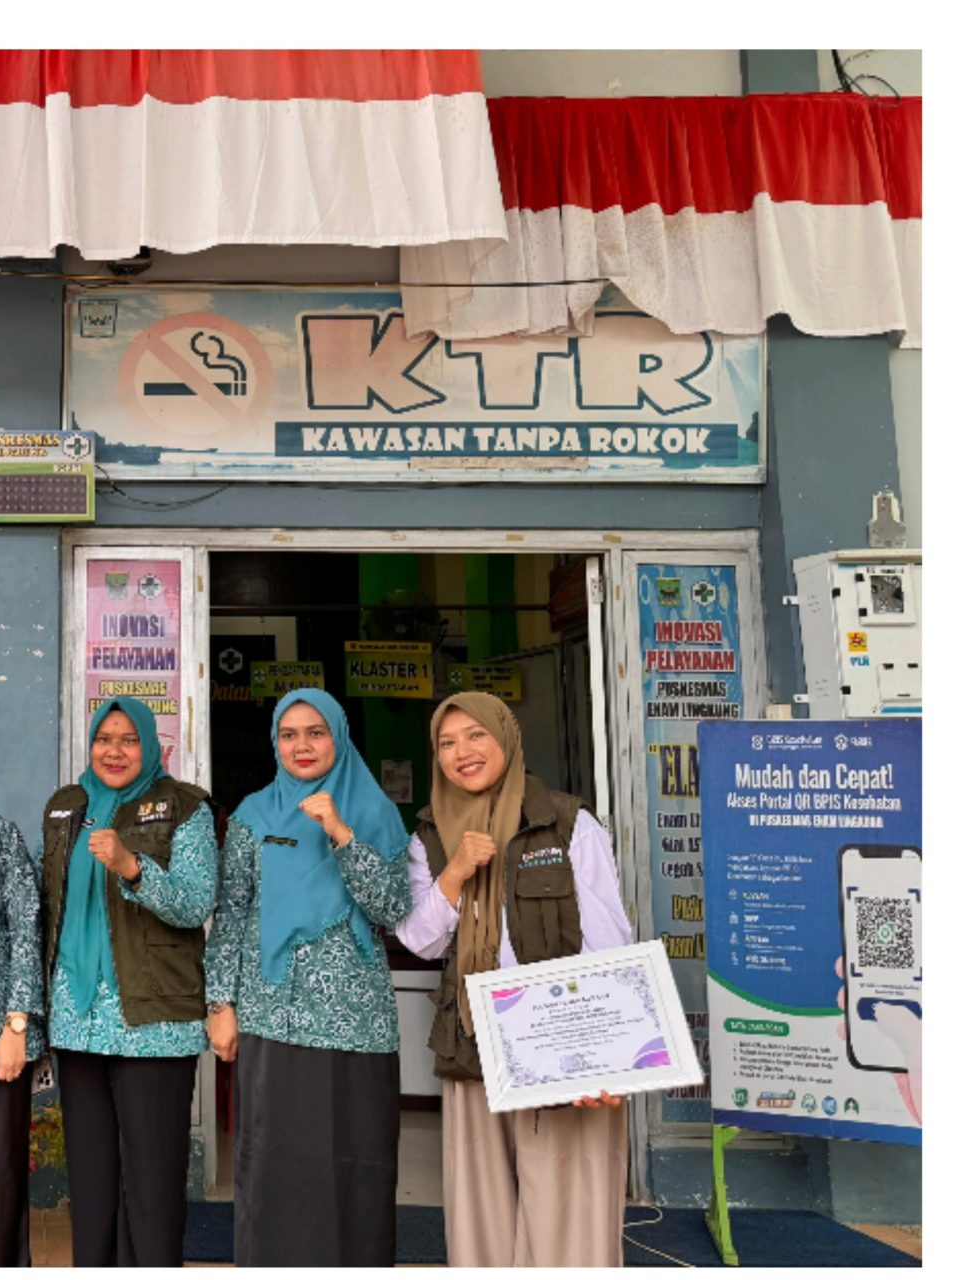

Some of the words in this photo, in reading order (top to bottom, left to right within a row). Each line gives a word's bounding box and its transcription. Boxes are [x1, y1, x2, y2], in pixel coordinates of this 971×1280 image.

[300, 311, 714, 415] KTR
[301, 426, 466, 453] KAWASAN
[472, 426, 582, 453] TANPA
[588, 426, 711, 454] ROKOK
[102, 614, 166, 638] INOVASI
[654, 621, 723, 643] INOVASI
[92, 646, 176, 671] PELAYANAN
[349, 660, 417, 679] KLASTER
[646, 650, 736, 672] PELAYANAN
[99, 679, 168, 697] PUSKESMAS
[657, 681, 727, 698] PUSKESMAS
[735, 763, 794, 790] Mudah
[798, 763, 831, 790] dan
[835, 763, 894, 795] Cepat!
[760, 793, 792, 810] Portal
